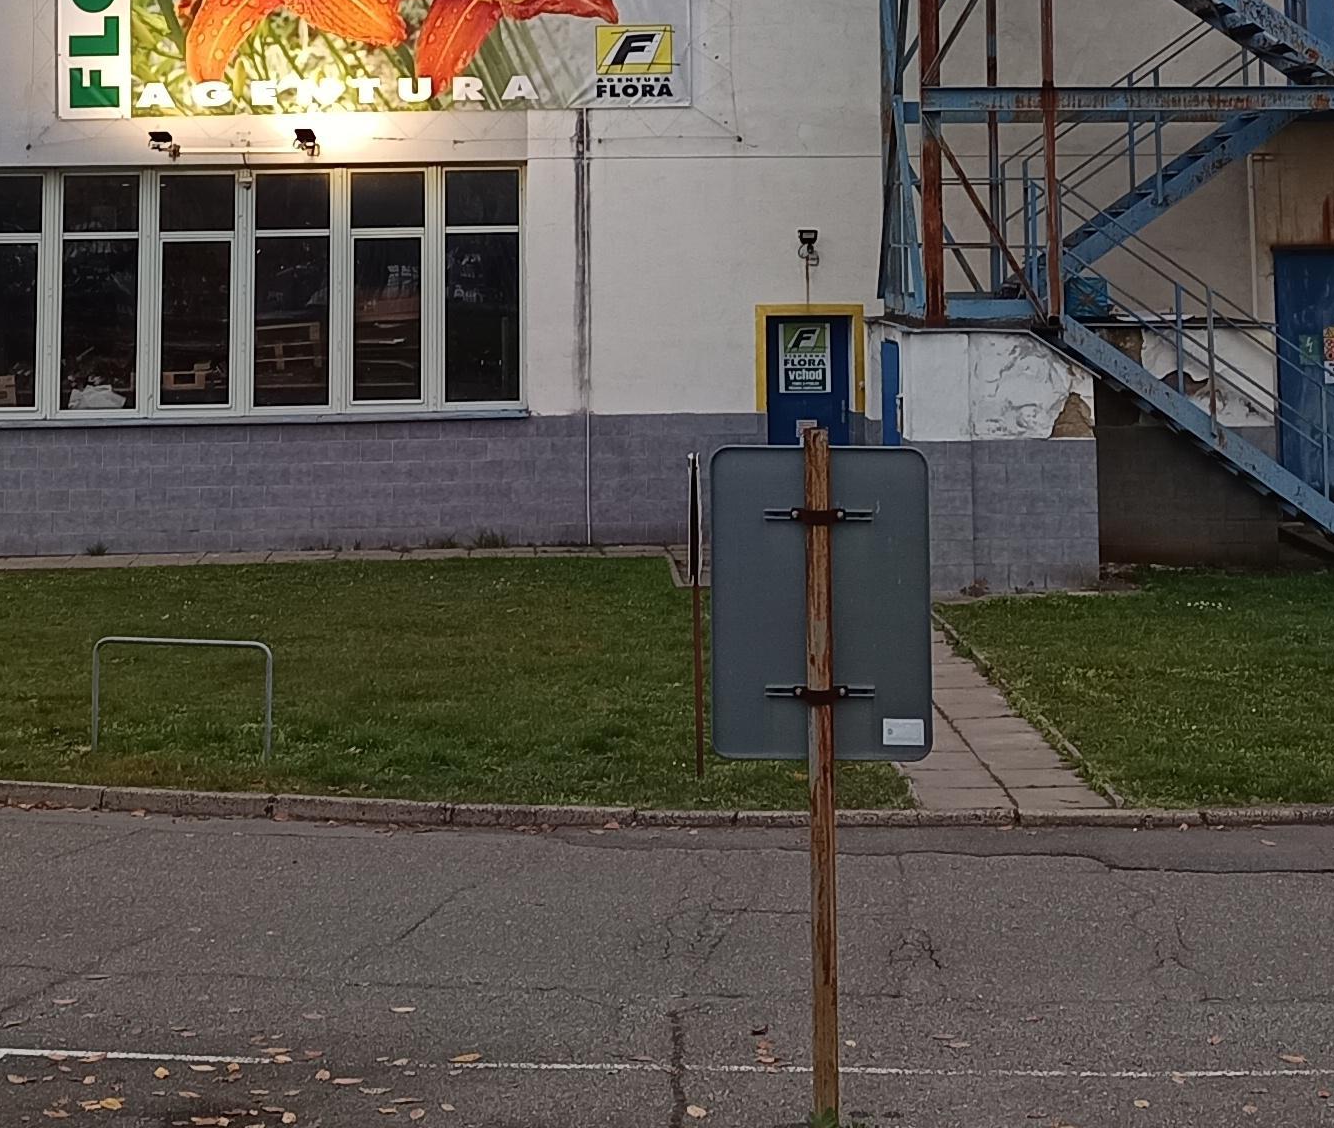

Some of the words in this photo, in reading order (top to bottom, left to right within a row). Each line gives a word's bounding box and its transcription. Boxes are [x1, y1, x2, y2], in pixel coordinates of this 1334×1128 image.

[135, 75, 539, 109] AGENTURA
[596, 83, 673, 97] FLORA
[784, 358, 826, 366] FLORA
[788, 369, 823, 380] vchod
